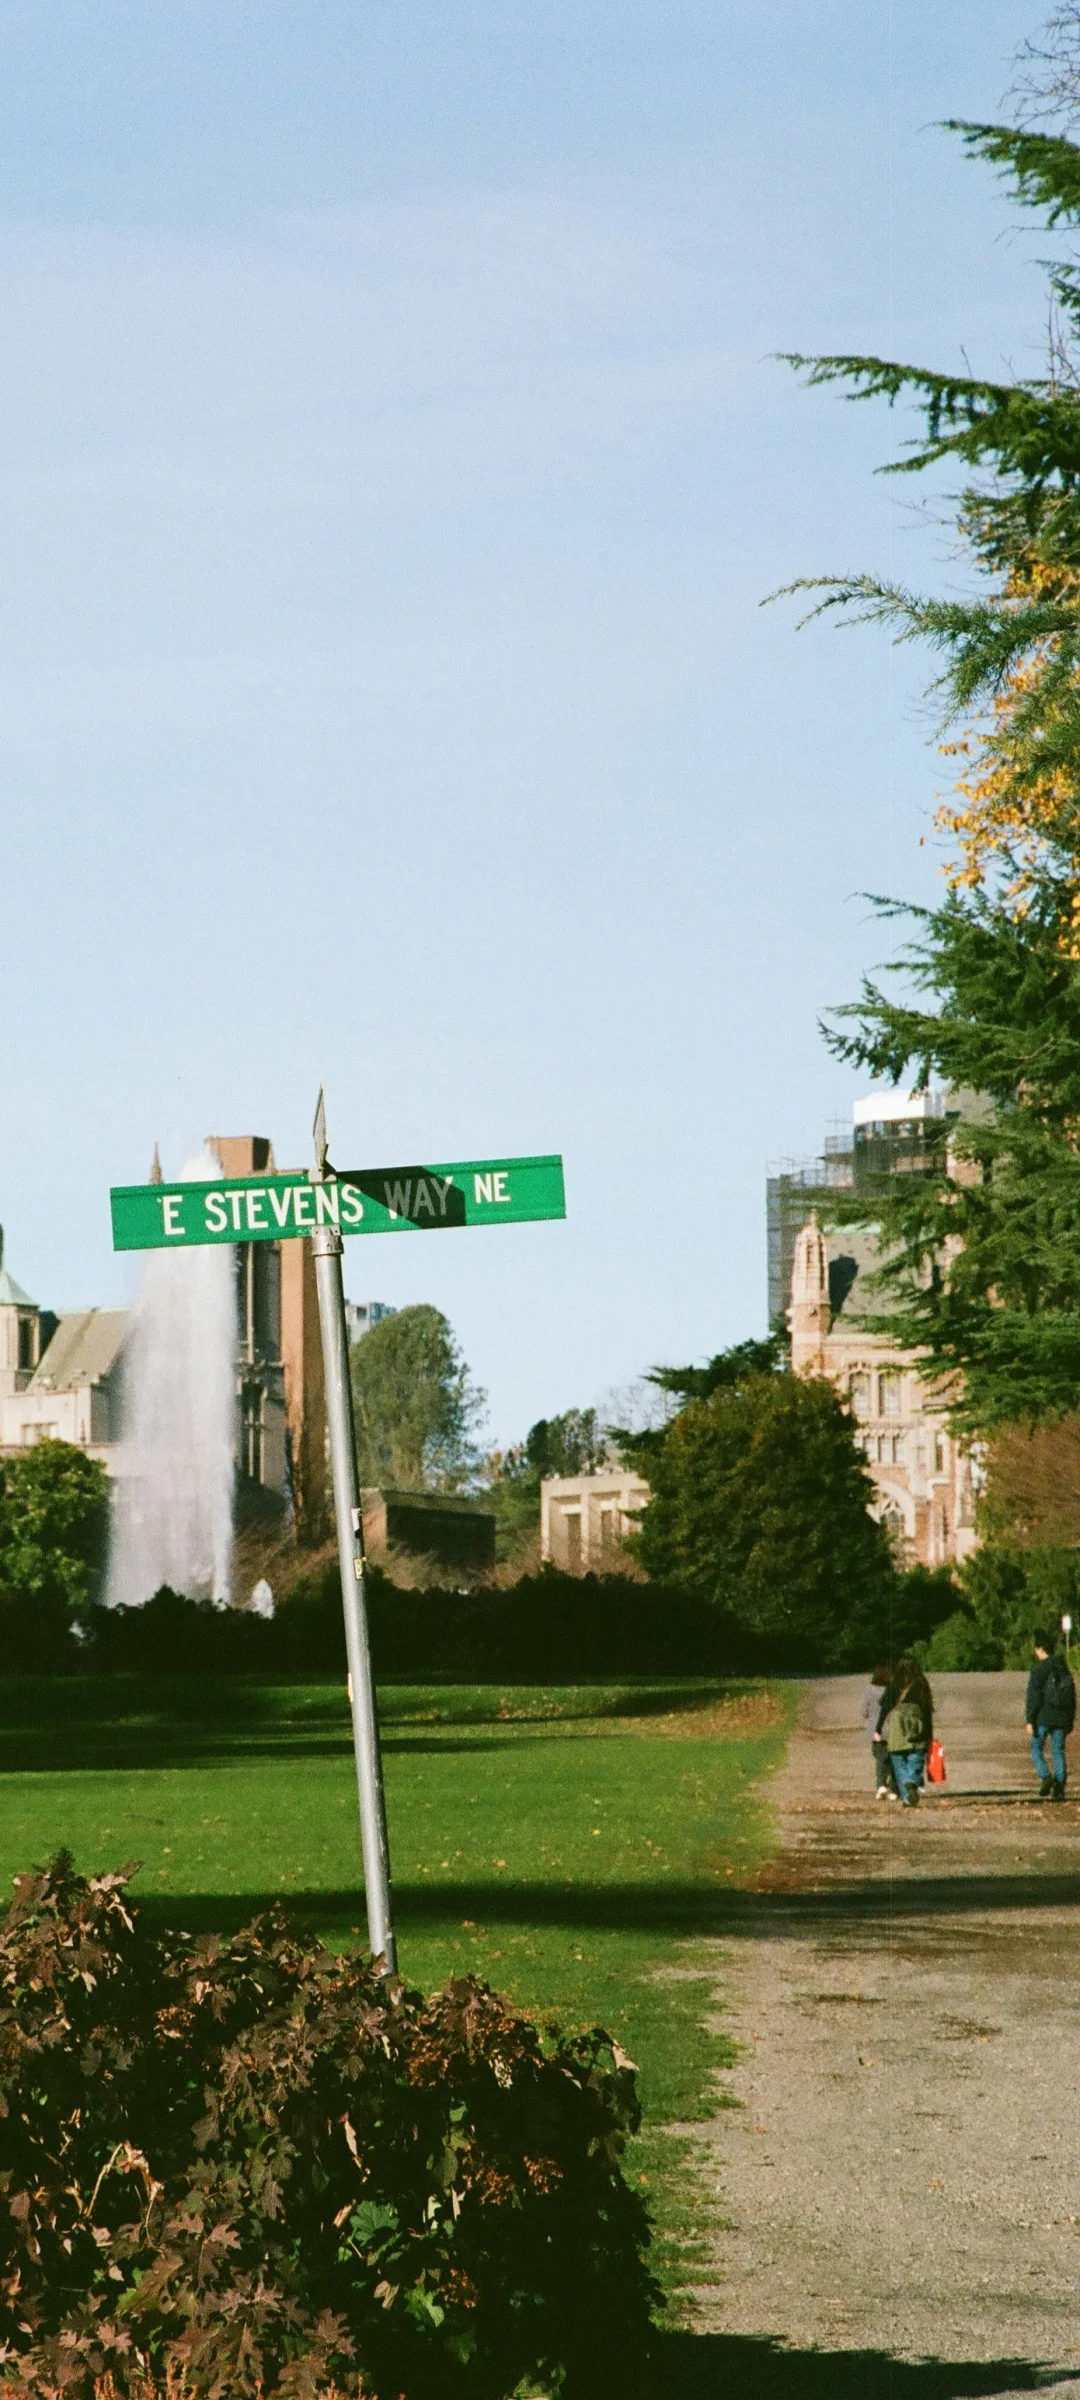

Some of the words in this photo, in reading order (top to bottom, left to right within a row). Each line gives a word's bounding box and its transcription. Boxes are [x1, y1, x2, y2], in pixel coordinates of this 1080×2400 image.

[163, 1195, 185, 1235] E
[205, 1184, 363, 1231] STEVENS
[383, 1176, 453, 1220] WAY
[474, 1172, 511, 1203] NE
